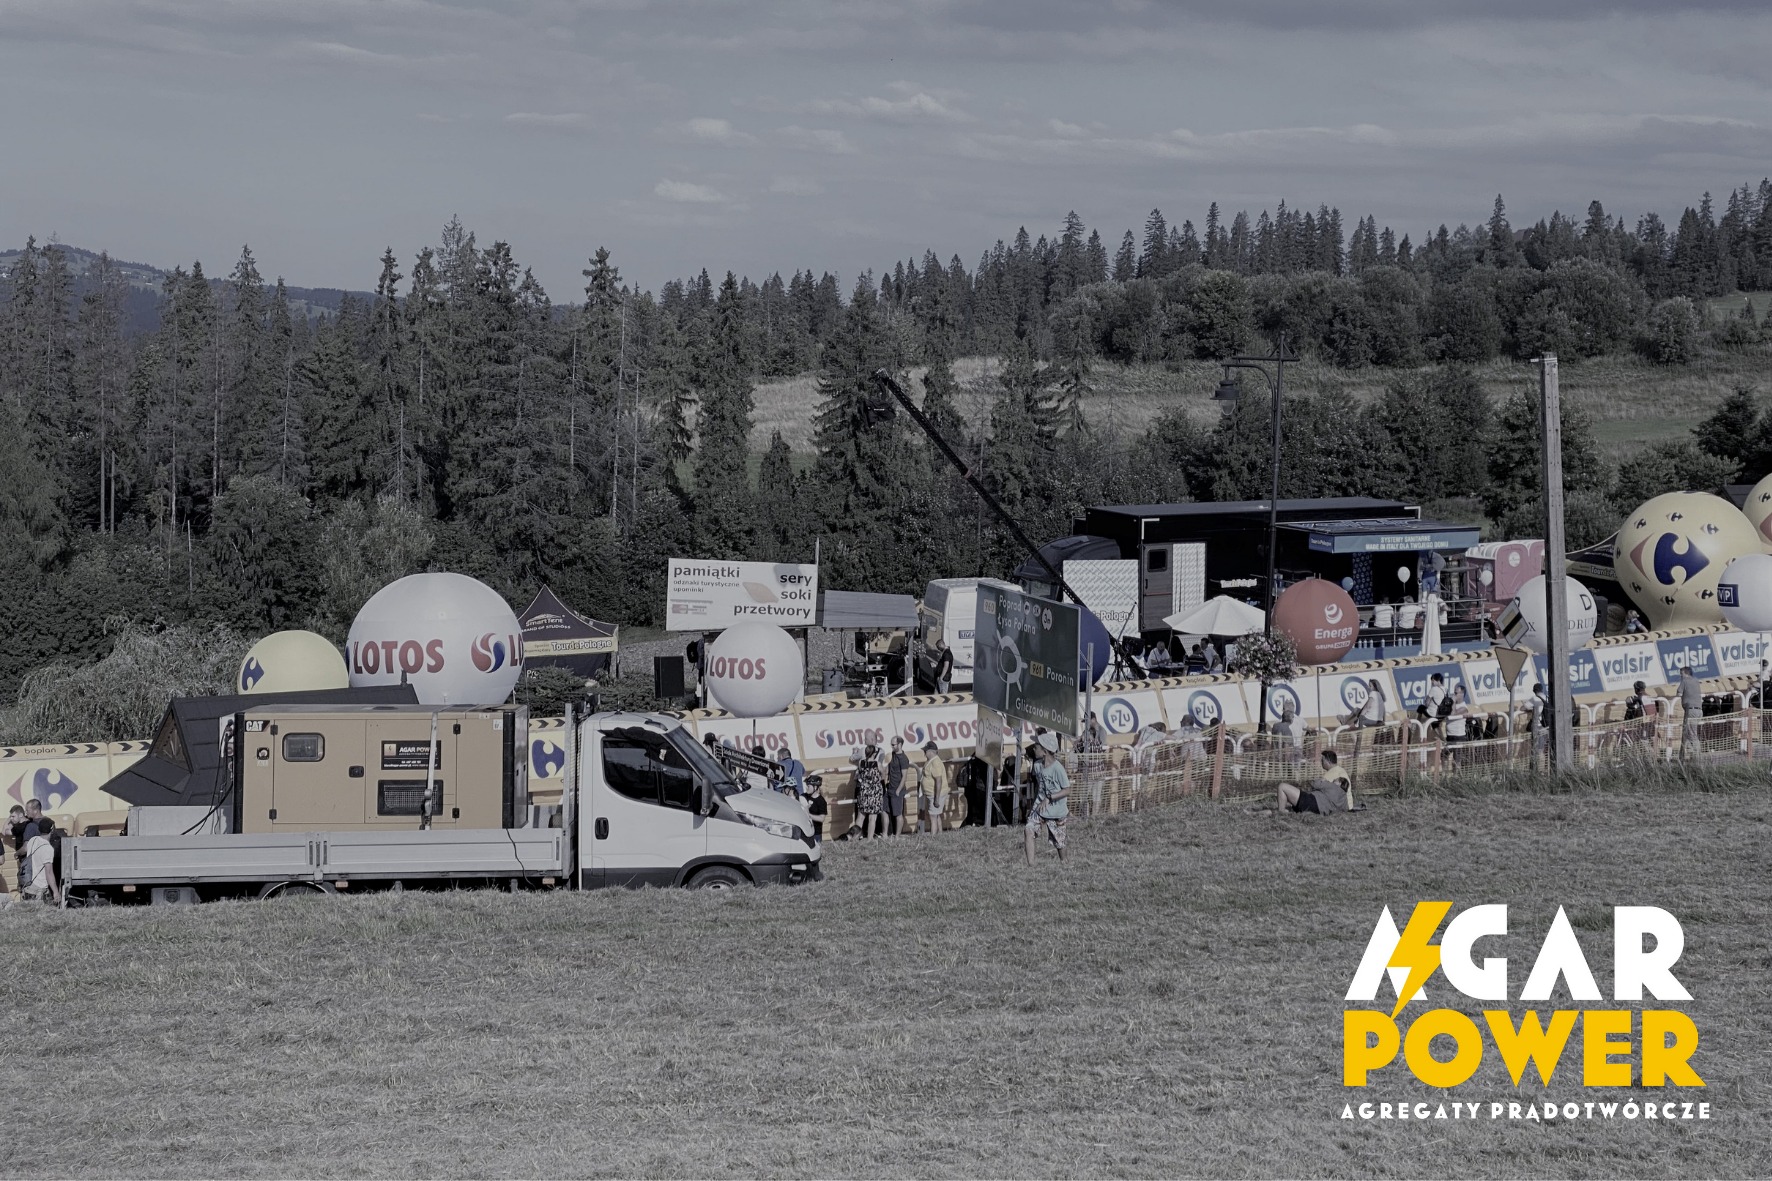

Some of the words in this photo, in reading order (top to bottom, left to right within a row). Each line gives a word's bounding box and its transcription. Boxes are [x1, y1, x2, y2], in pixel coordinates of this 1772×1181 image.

[673, 565, 740, 579] pamiątki
[779, 574, 812, 586] sery
[700, 580, 740, 588] turystyczne
[780, 589, 812, 600] soki
[999, 594, 1021, 612] Poprad
[733, 604, 811, 619] przetwory
[984, 600, 995, 613] 960
[1013, 617, 1036, 635] Polana
[1314, 626, 1353, 640] Energa
[353, 639, 445, 675] LOTOS
[1664, 644, 1712, 670] valsir
[1720, 636, 1770, 662] valsir
[709, 655, 767, 680] LOTOS
[1602, 651, 1654, 676] valsir
[1032, 663, 1041, 677] 961
[1046, 666, 1075, 687] Poronin
[1472, 666, 1529, 691] valr
[1400, 672, 1461, 699] valir
[1348, 687, 1366, 704] PZU
[1015, 697, 1050, 720] Gliczarów
[1051, 709, 1073, 730] Dolny
[1110, 709, 1131, 727] PZU
[1195, 702, 1215, 719] PZU
[245, 720, 264, 732] CAT
[836, 727, 885, 746] LOTS
